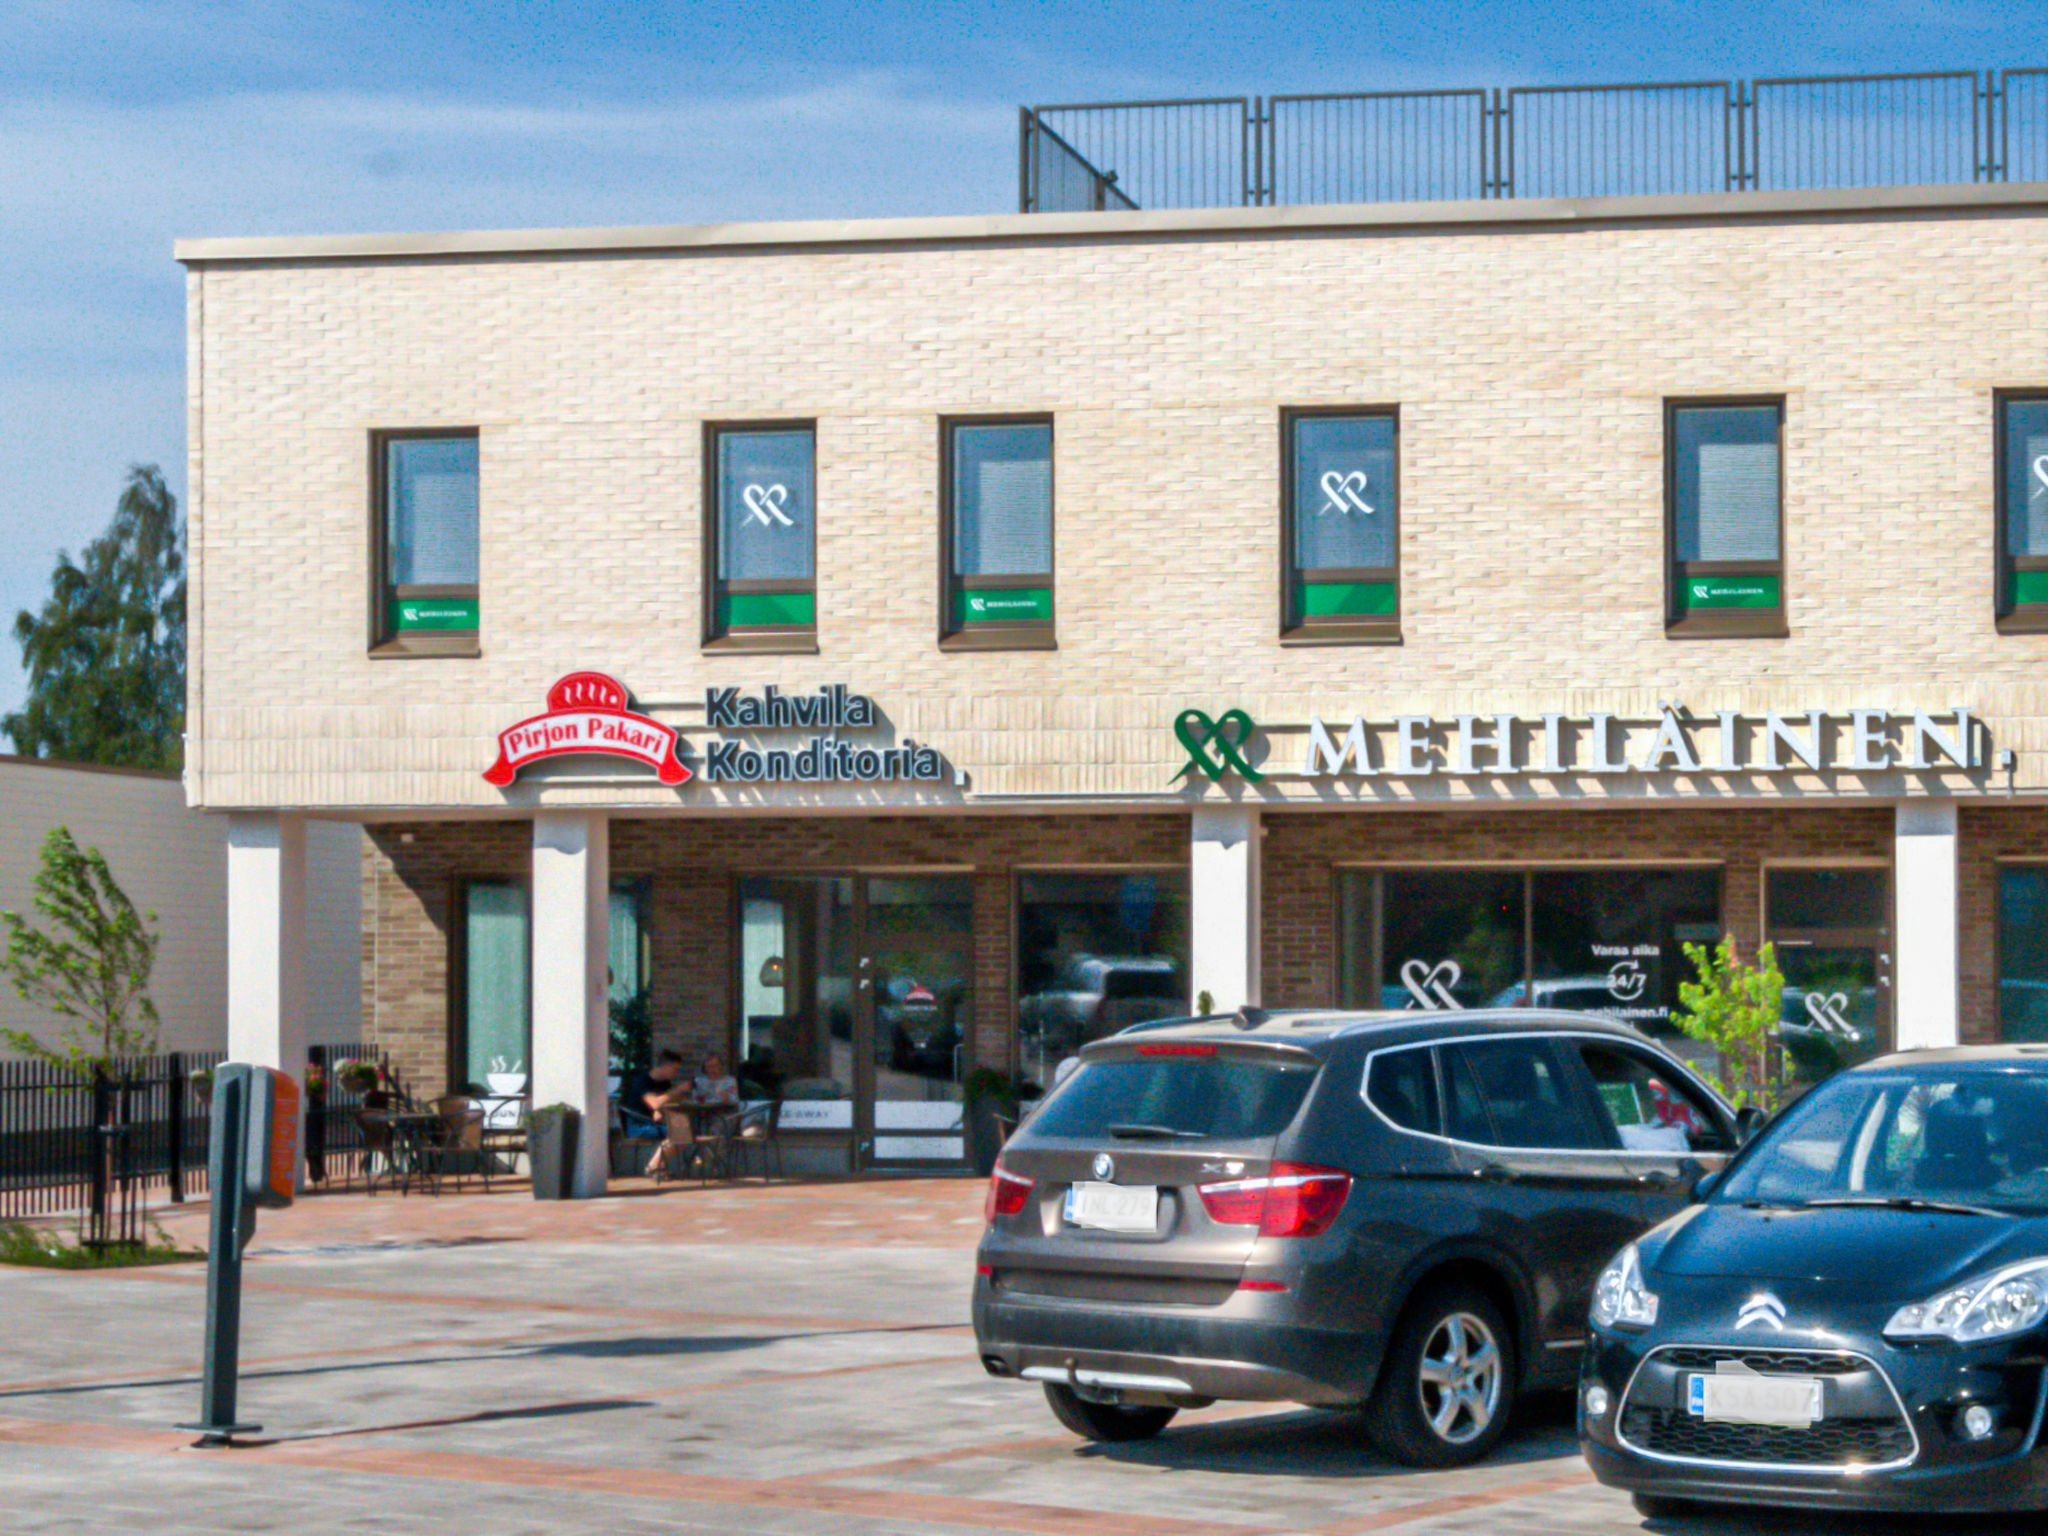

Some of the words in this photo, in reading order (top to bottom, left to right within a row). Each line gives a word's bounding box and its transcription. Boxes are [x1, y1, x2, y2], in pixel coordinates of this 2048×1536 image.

[706, 684, 876, 727] Kahvila
[508, 723, 579, 754] Pirjon
[588, 718, 664, 754] Pakari
[1300, 699, 1977, 776] MEHILÄINEN
[706, 737, 941, 781] Konditoria
[1591, 944, 1630, 956] Varaa
[1632, 944, 1660, 956] aika
[1606, 973, 1647, 989] 24/7
